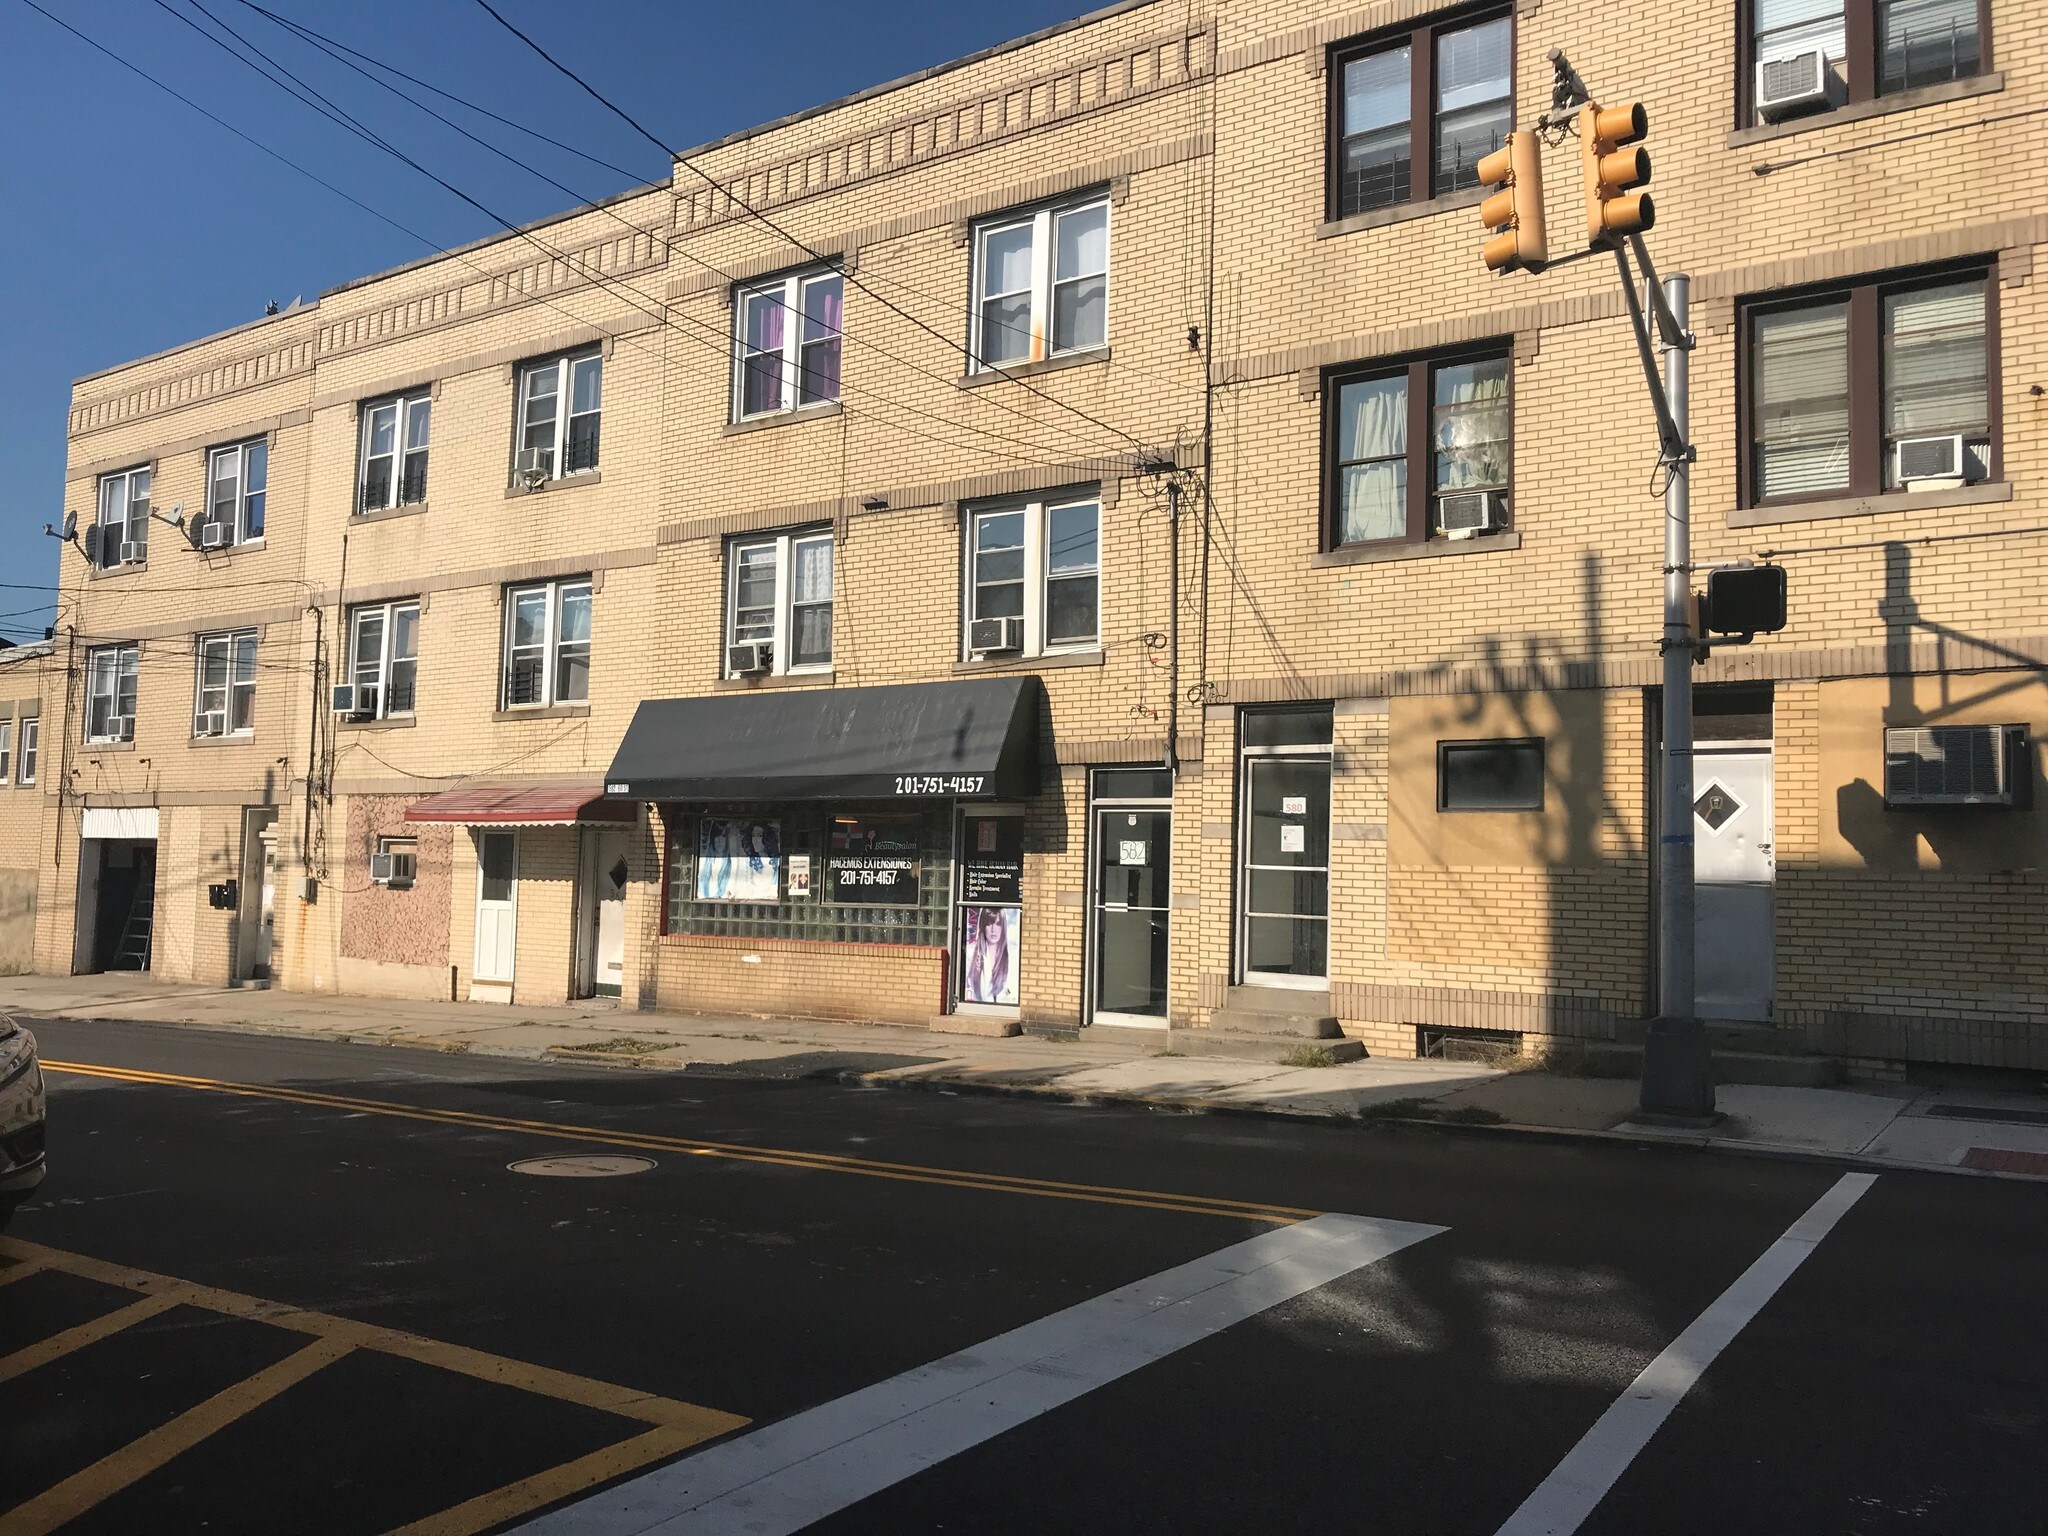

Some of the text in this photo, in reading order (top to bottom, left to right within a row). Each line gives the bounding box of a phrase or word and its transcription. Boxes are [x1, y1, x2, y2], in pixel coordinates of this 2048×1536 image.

[895, 776, 984, 794] 201-751-4157
[1285, 803, 1303, 813] 580
[1120, 840, 1146, 861] 582
[830, 857, 912, 870] HACEMOS EXTENSIONES
[840, 870, 898, 885] 201-751-4157
